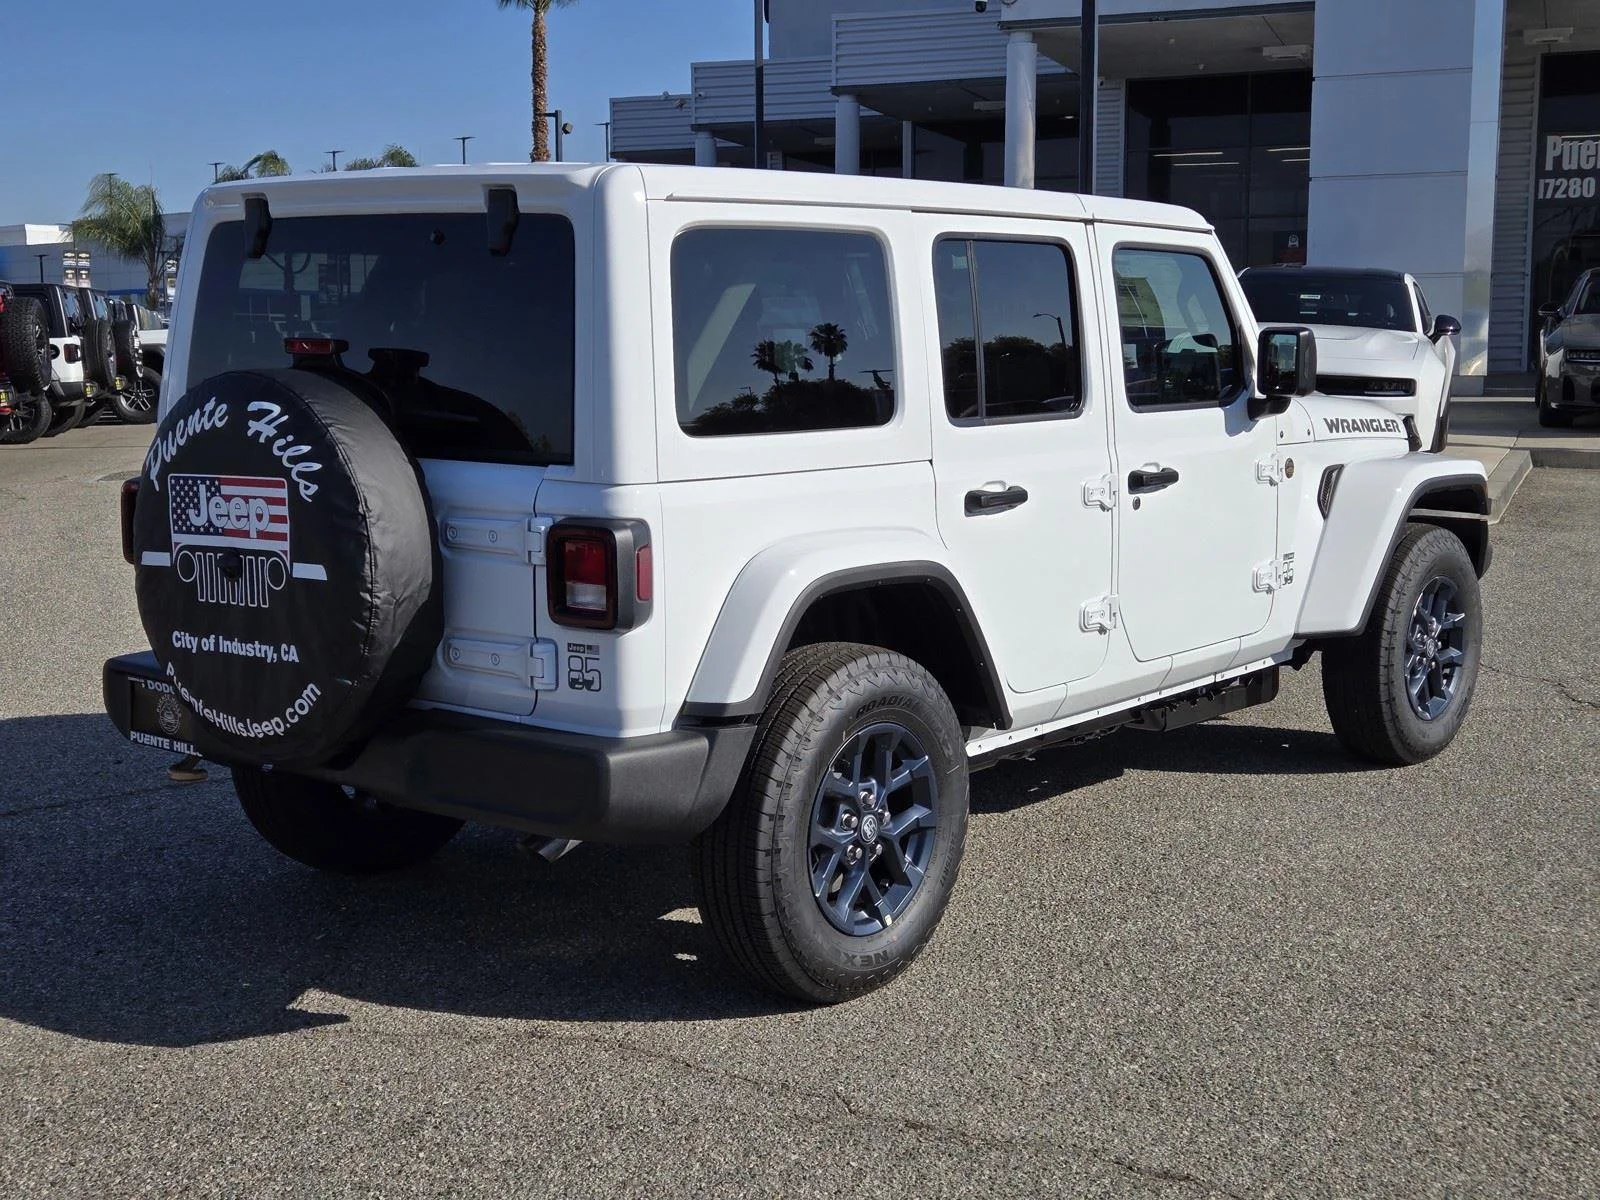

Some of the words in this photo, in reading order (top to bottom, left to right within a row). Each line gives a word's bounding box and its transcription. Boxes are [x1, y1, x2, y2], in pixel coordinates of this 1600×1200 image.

[1537, 177, 1596, 199] 17280
[1323, 417, 1401, 434] WRANGLER
[146, 397, 229, 492] Puente
[247, 401, 323, 503] Hills
[188, 484, 270, 539] Jeep
[172, 630, 199, 653] City
[201, 634, 216, 652] of
[219, 636, 278, 663] Industry,
[281, 643, 299, 663] CA
[568, 643, 585, 653] Jeep
[568, 655, 602, 692] 85
[130, 731, 171, 750] PUENTE
[173, 740, 203, 757] HILL
